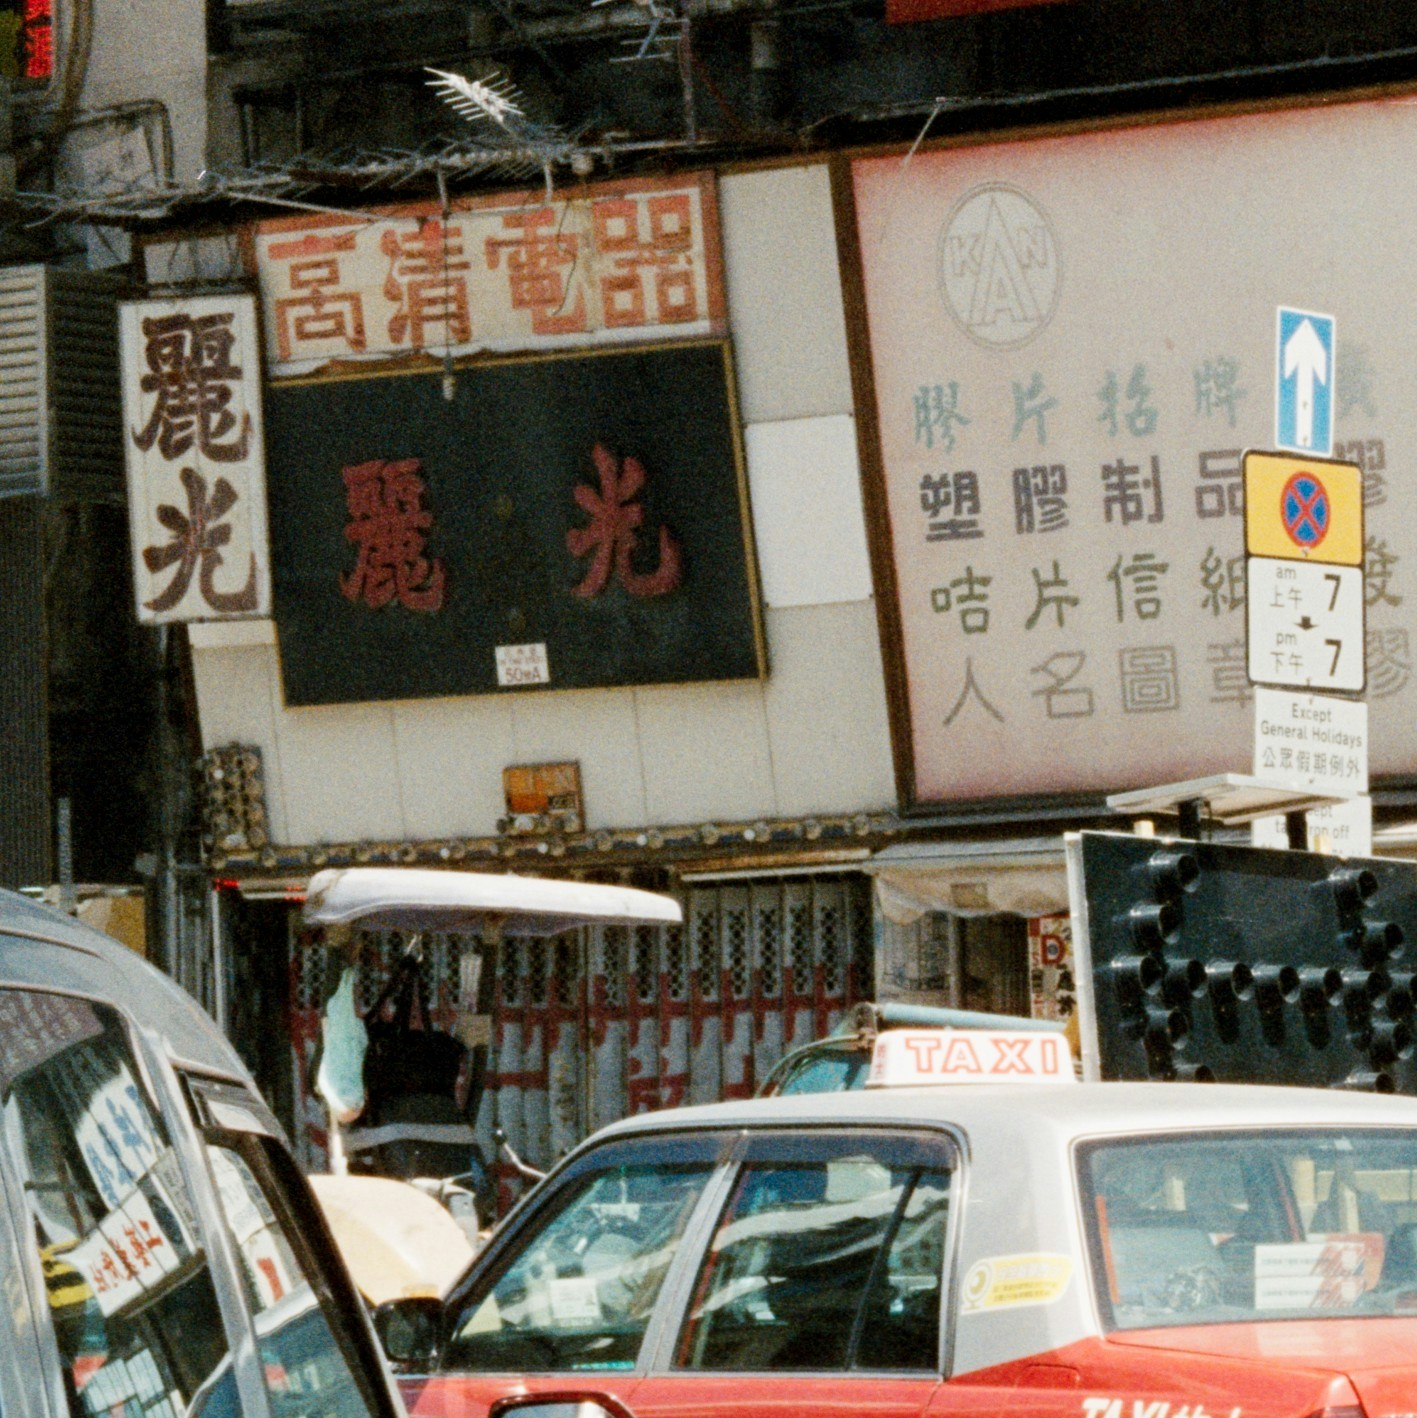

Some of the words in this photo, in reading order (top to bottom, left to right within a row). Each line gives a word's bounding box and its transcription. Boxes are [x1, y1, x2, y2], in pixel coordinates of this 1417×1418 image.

[268, 193, 695, 359] 高清電器
[132, 311, 259, 612] 麗光
[339, 442, 684, 613] 麗光
[1269, 584, 1304, 611] 上午
[1275, 567, 1298, 581] am
[1323, 573, 1342, 612] 7
[1269, 651, 1305, 677] 下午
[1275, 632, 1298, 647] pm
[1324, 638, 1343, 677] 7
[1291, 702, 1332, 724] Except
[1260, 720, 1308, 741] General
[1311, 726, 1363, 749] Holidays
[904, 1036, 1060, 1076] TAXI
